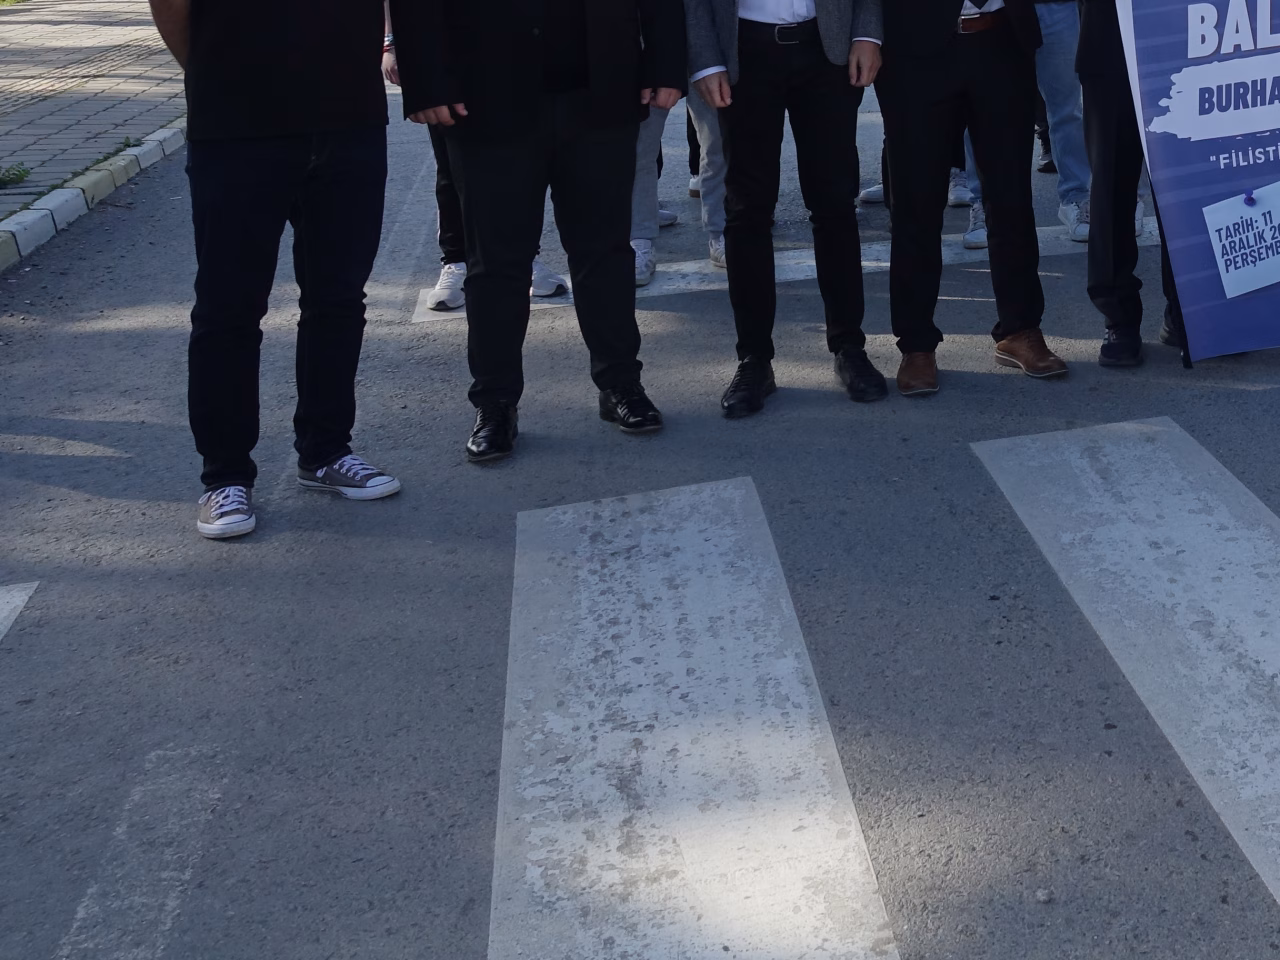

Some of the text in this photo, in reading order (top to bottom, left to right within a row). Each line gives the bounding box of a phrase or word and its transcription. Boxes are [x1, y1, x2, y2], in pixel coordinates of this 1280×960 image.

[1215, 210, 1273, 243] TARİH: 11
[1221, 228, 1267, 259] ARALIK
